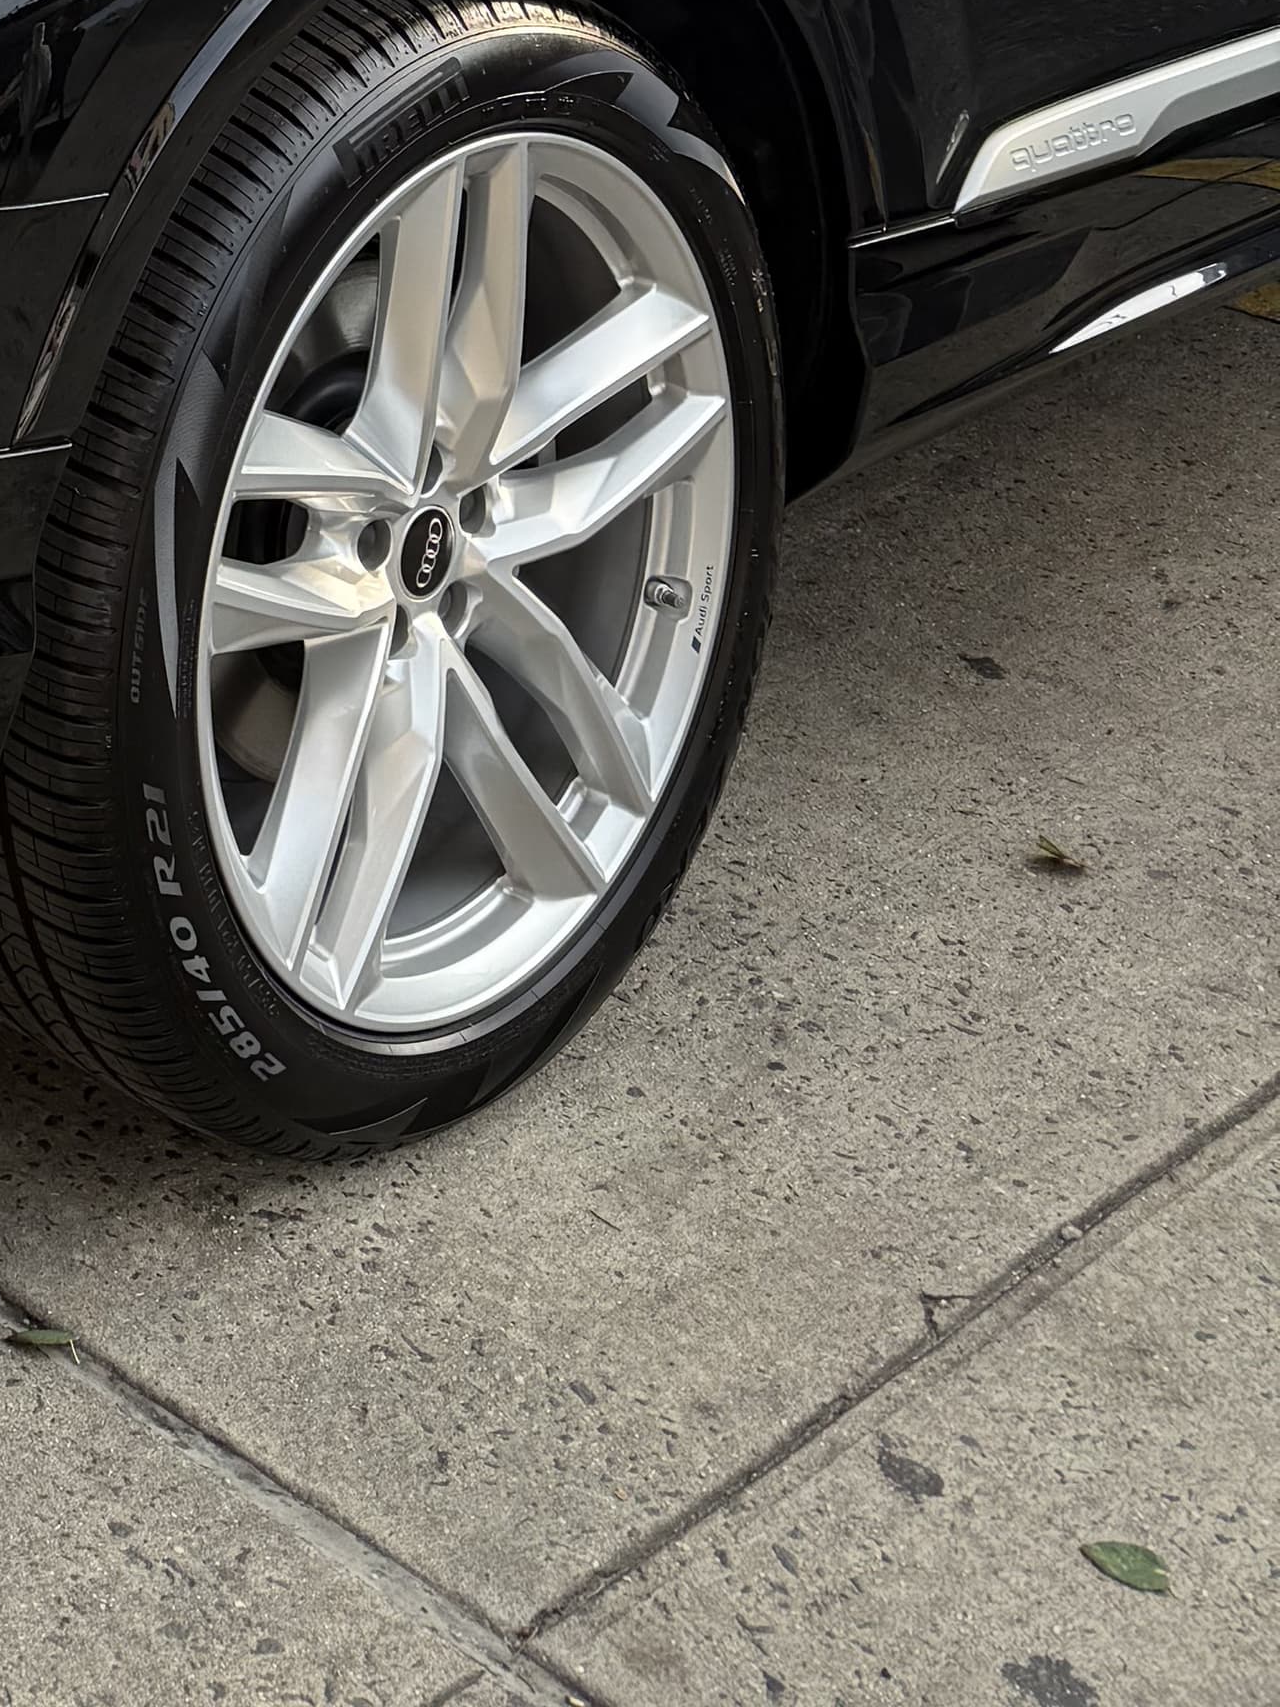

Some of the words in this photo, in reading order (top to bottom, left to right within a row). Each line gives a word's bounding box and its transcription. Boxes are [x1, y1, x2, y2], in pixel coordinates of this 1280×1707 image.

[1010, 113, 1137, 173] quattro
[700, 565, 715, 602] Sport
[130, 588, 148, 704] OUTSIDE
[695, 606, 708, 636] Audi
[169, 916, 288, 1082] 285/40
